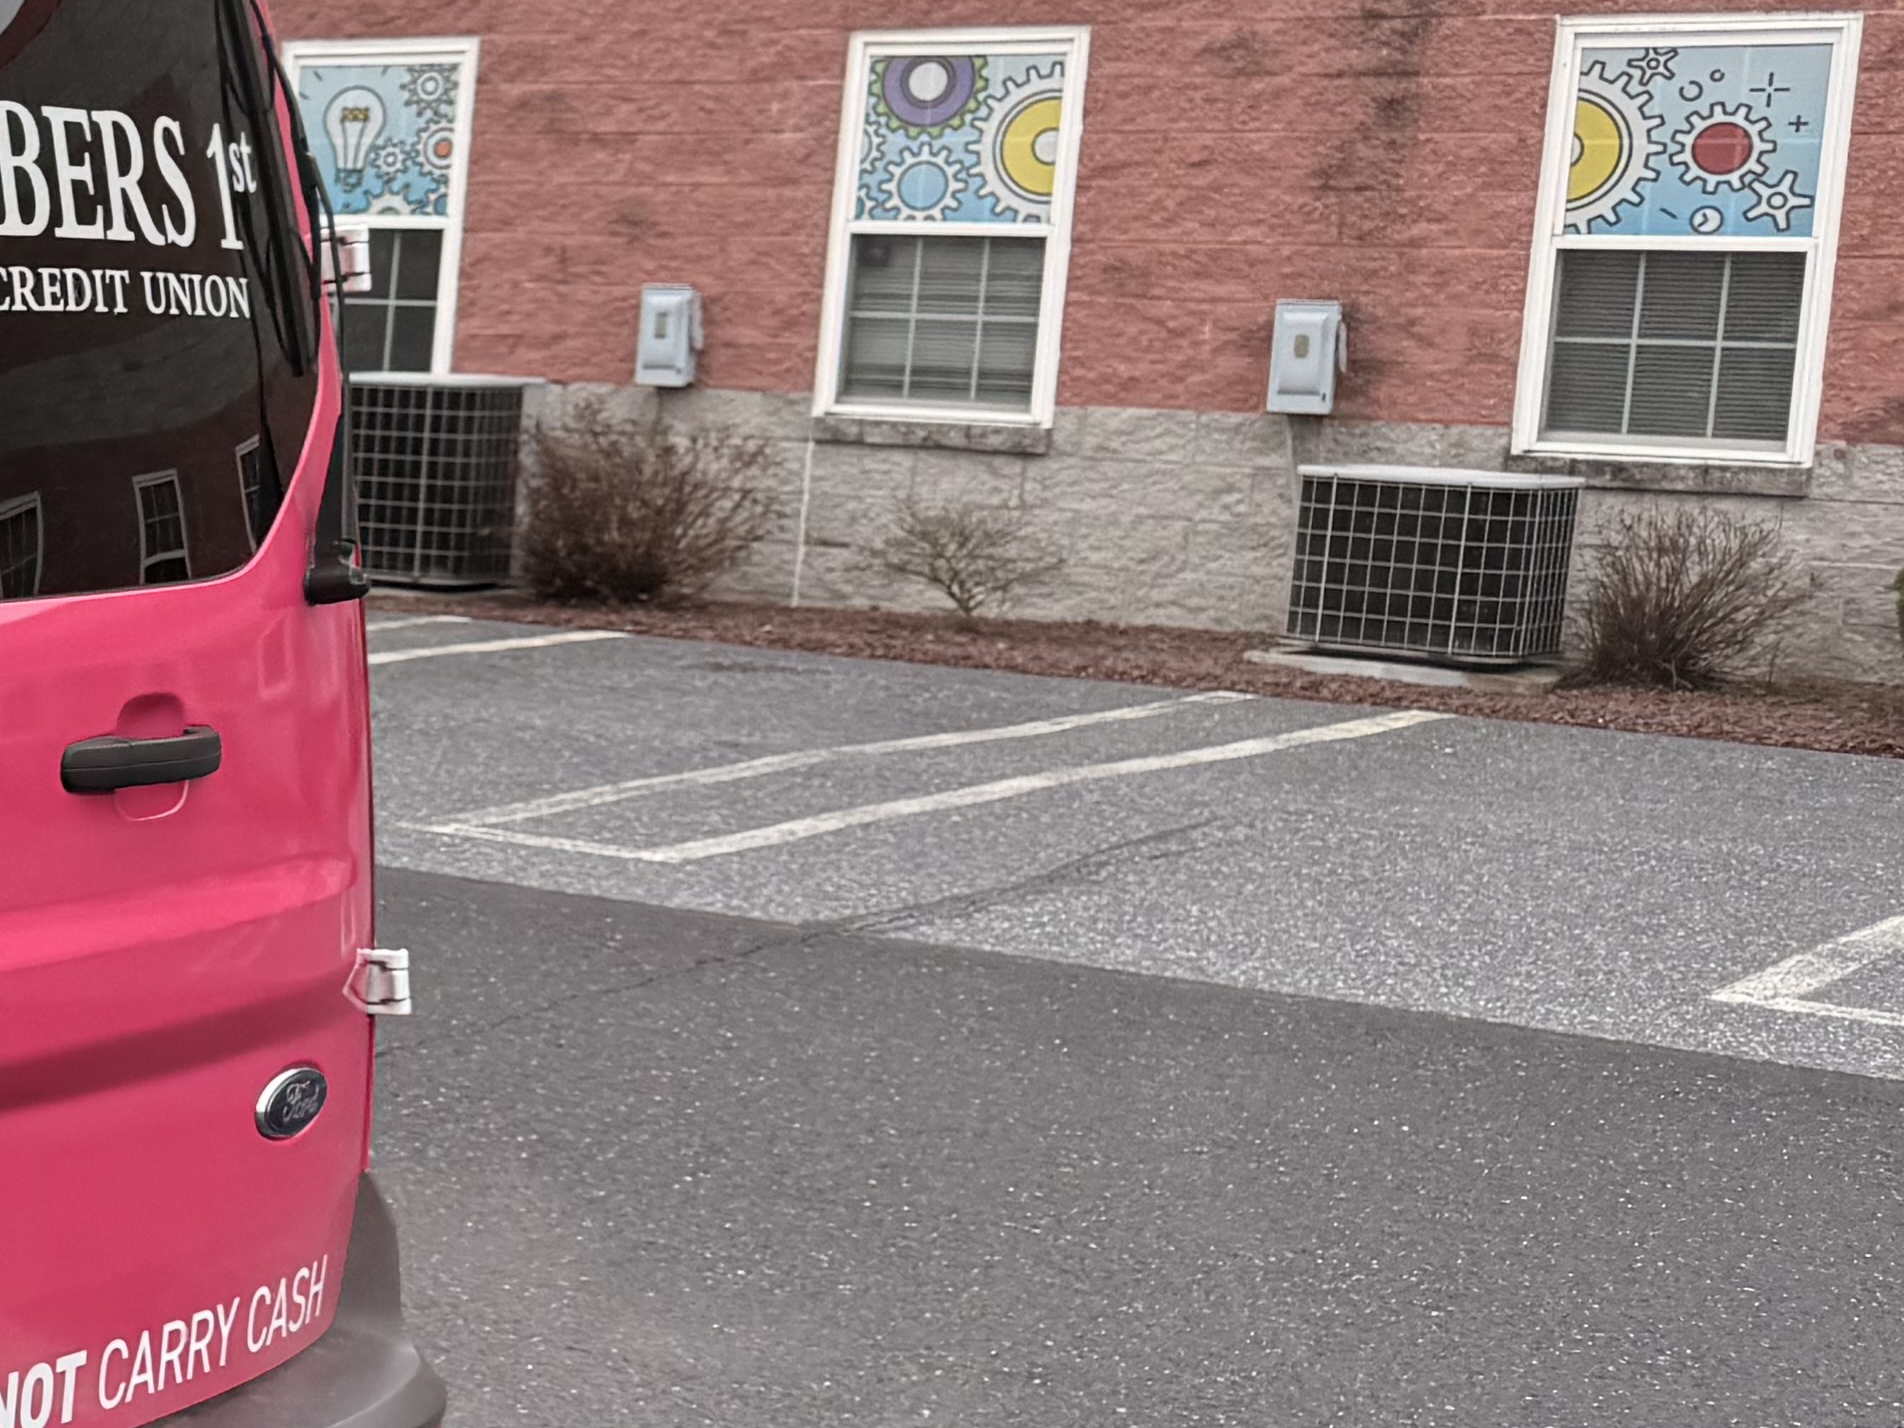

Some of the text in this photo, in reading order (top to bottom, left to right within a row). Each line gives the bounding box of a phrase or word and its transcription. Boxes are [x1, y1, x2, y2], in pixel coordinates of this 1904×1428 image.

[206, 123, 258, 250] 1st
[140, 271, 252, 319] UNION
[97, 1295, 240, 1411] CARRY
[245, 1255, 327, 1354] CASH
